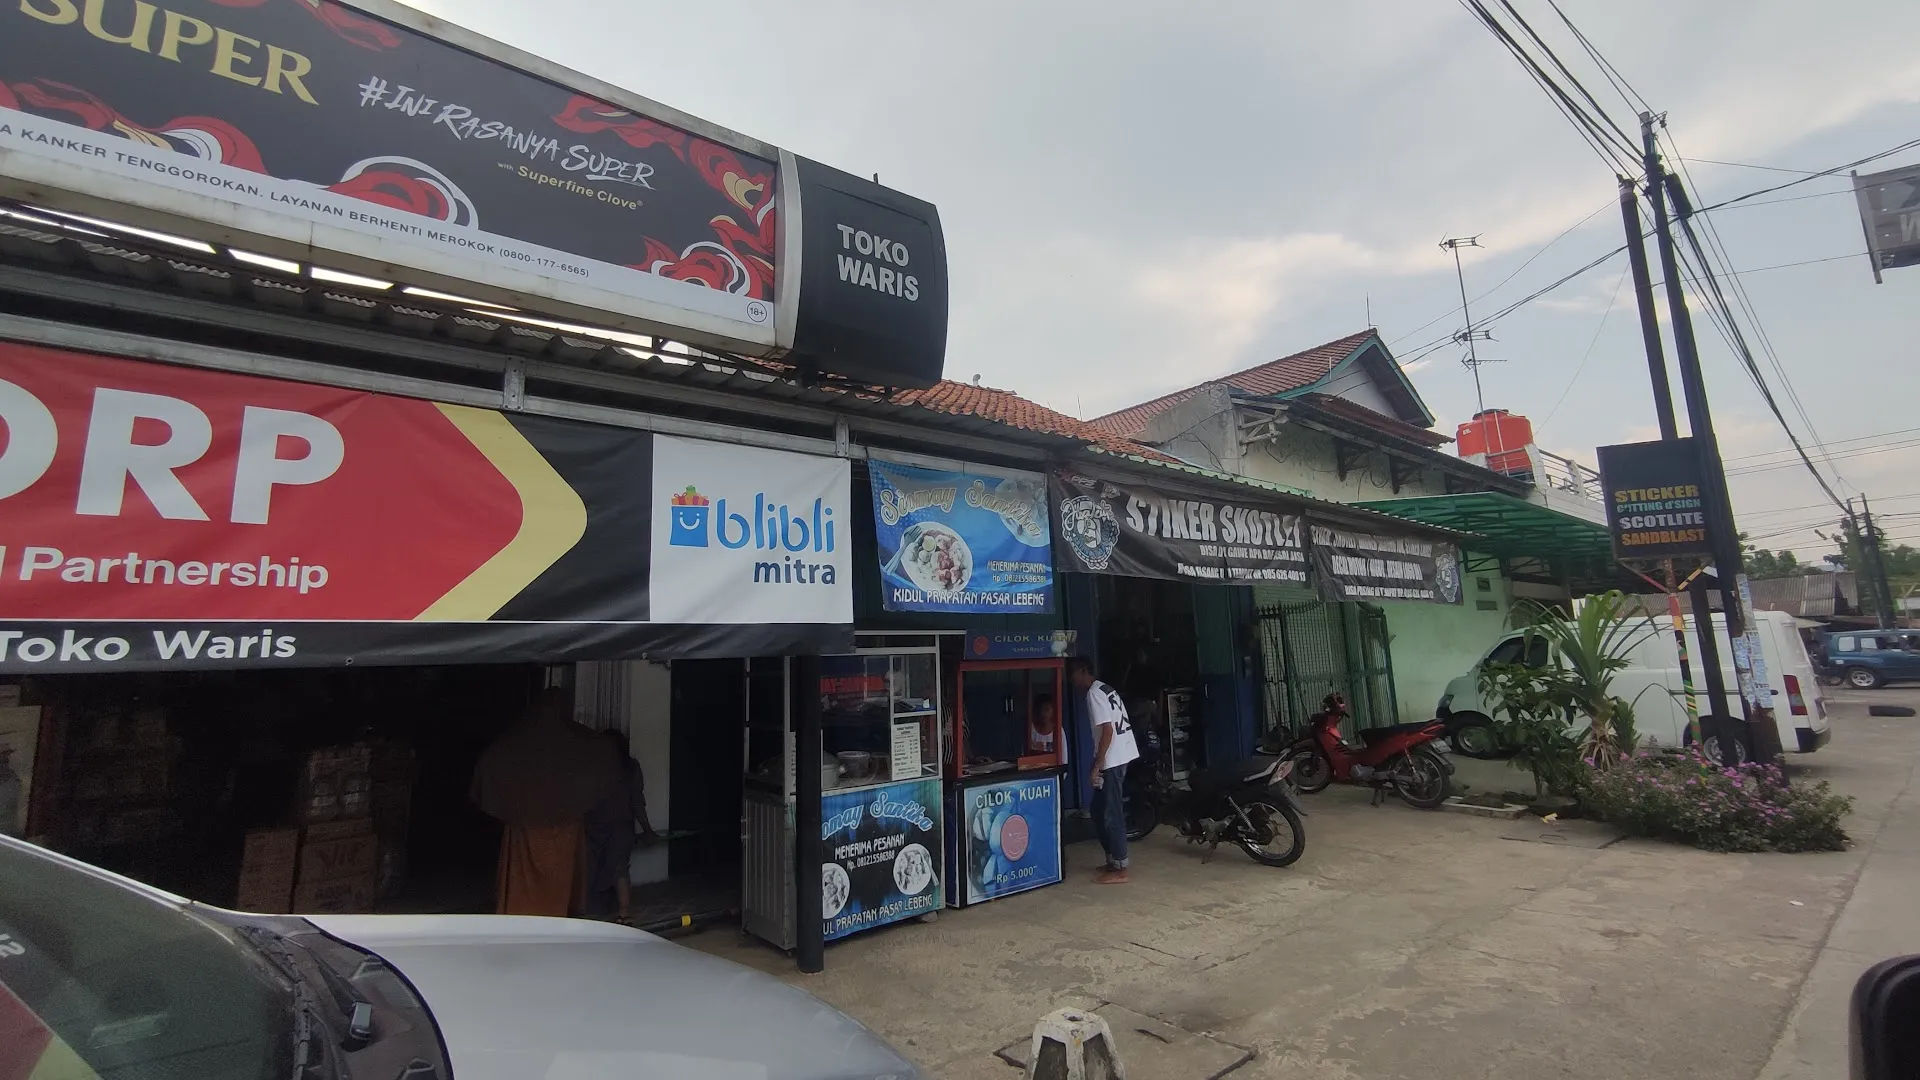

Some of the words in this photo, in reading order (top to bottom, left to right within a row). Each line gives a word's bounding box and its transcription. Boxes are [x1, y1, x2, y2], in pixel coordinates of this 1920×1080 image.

[497, 162, 514, 171] with
[517, 165, 594, 198] Superfine
[21, 128, 107, 158] KANKER
[115, 152, 264, 197] TENGGOROKAN.
[270, 191, 344, 217] LAYANAN
[349, 210, 422, 237] BERHENTI
[427, 231, 495, 255] MEROKOK
[499, 248, 590, 279] (0800-177-6565)
[837, 223, 909, 267] TOKO
[837, 253, 919, 302] WARIS
[749, 306, 765, 317] 18+
[1614, 484, 1699, 503] STICKER
[716, 492, 835, 553] blibli
[1126, 494, 1217, 541] STIKER
[1619, 511, 1705, 530] SCOTLITE
[1621, 528, 1706, 546] SANDBLAST
[19, 546, 329, 594] Partnership
[754, 555, 836, 585] mitra
[893, 588, 924, 603] KIDUL
[926, 590, 978, 605] PRAPATAN
[980, 592, 1011, 605] PASAR
[1012, 592, 1045, 606] LEBENG
[0, 629, 130, 662] Toko
[153, 629, 297, 660] Waris
[994, 635, 1030, 643] CILOK
[870, 791, 934, 832] Santika
[975, 790, 1013, 809] CILOK
[1019, 784, 1051, 801] KUAH
[834, 840, 872, 860] MENERIMA
[873, 833, 906, 852] PESANAN
[836, 908, 877, 932] PRAPATAN
[879, 900, 903, 918] PASAR
[904, 894, 933, 911] LEBENG
